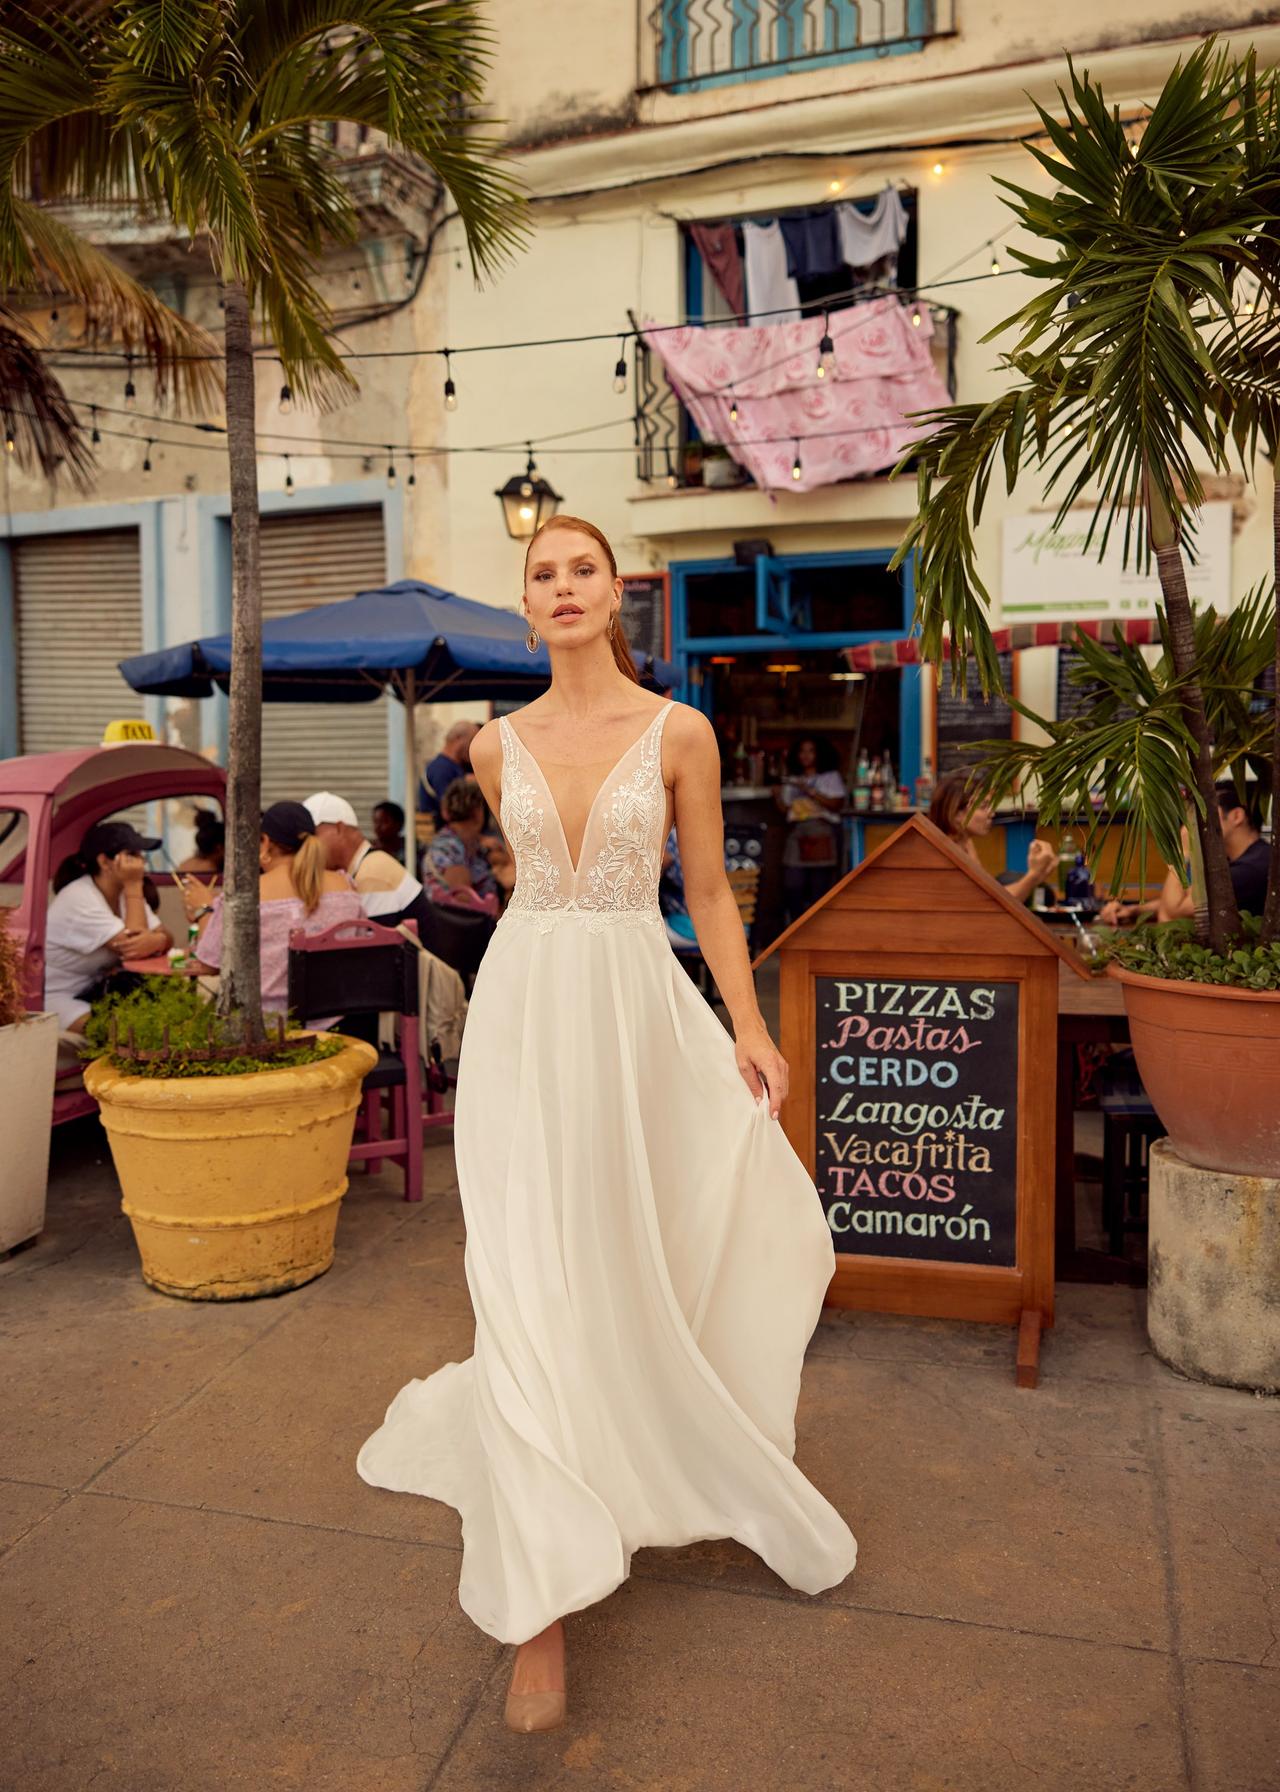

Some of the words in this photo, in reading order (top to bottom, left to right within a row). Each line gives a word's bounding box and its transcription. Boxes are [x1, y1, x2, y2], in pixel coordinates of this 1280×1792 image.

[122, 723, 153, 740] TAXI
[834, 982, 996, 1020] PIZZAS
[829, 1015, 982, 1054] Pastas
[830, 1055, 959, 1088] CERDO
[827, 1092, 1005, 1136] Langosta
[828, 1166, 956, 1203] TACOS
[827, 1201, 991, 1241] Camarón
